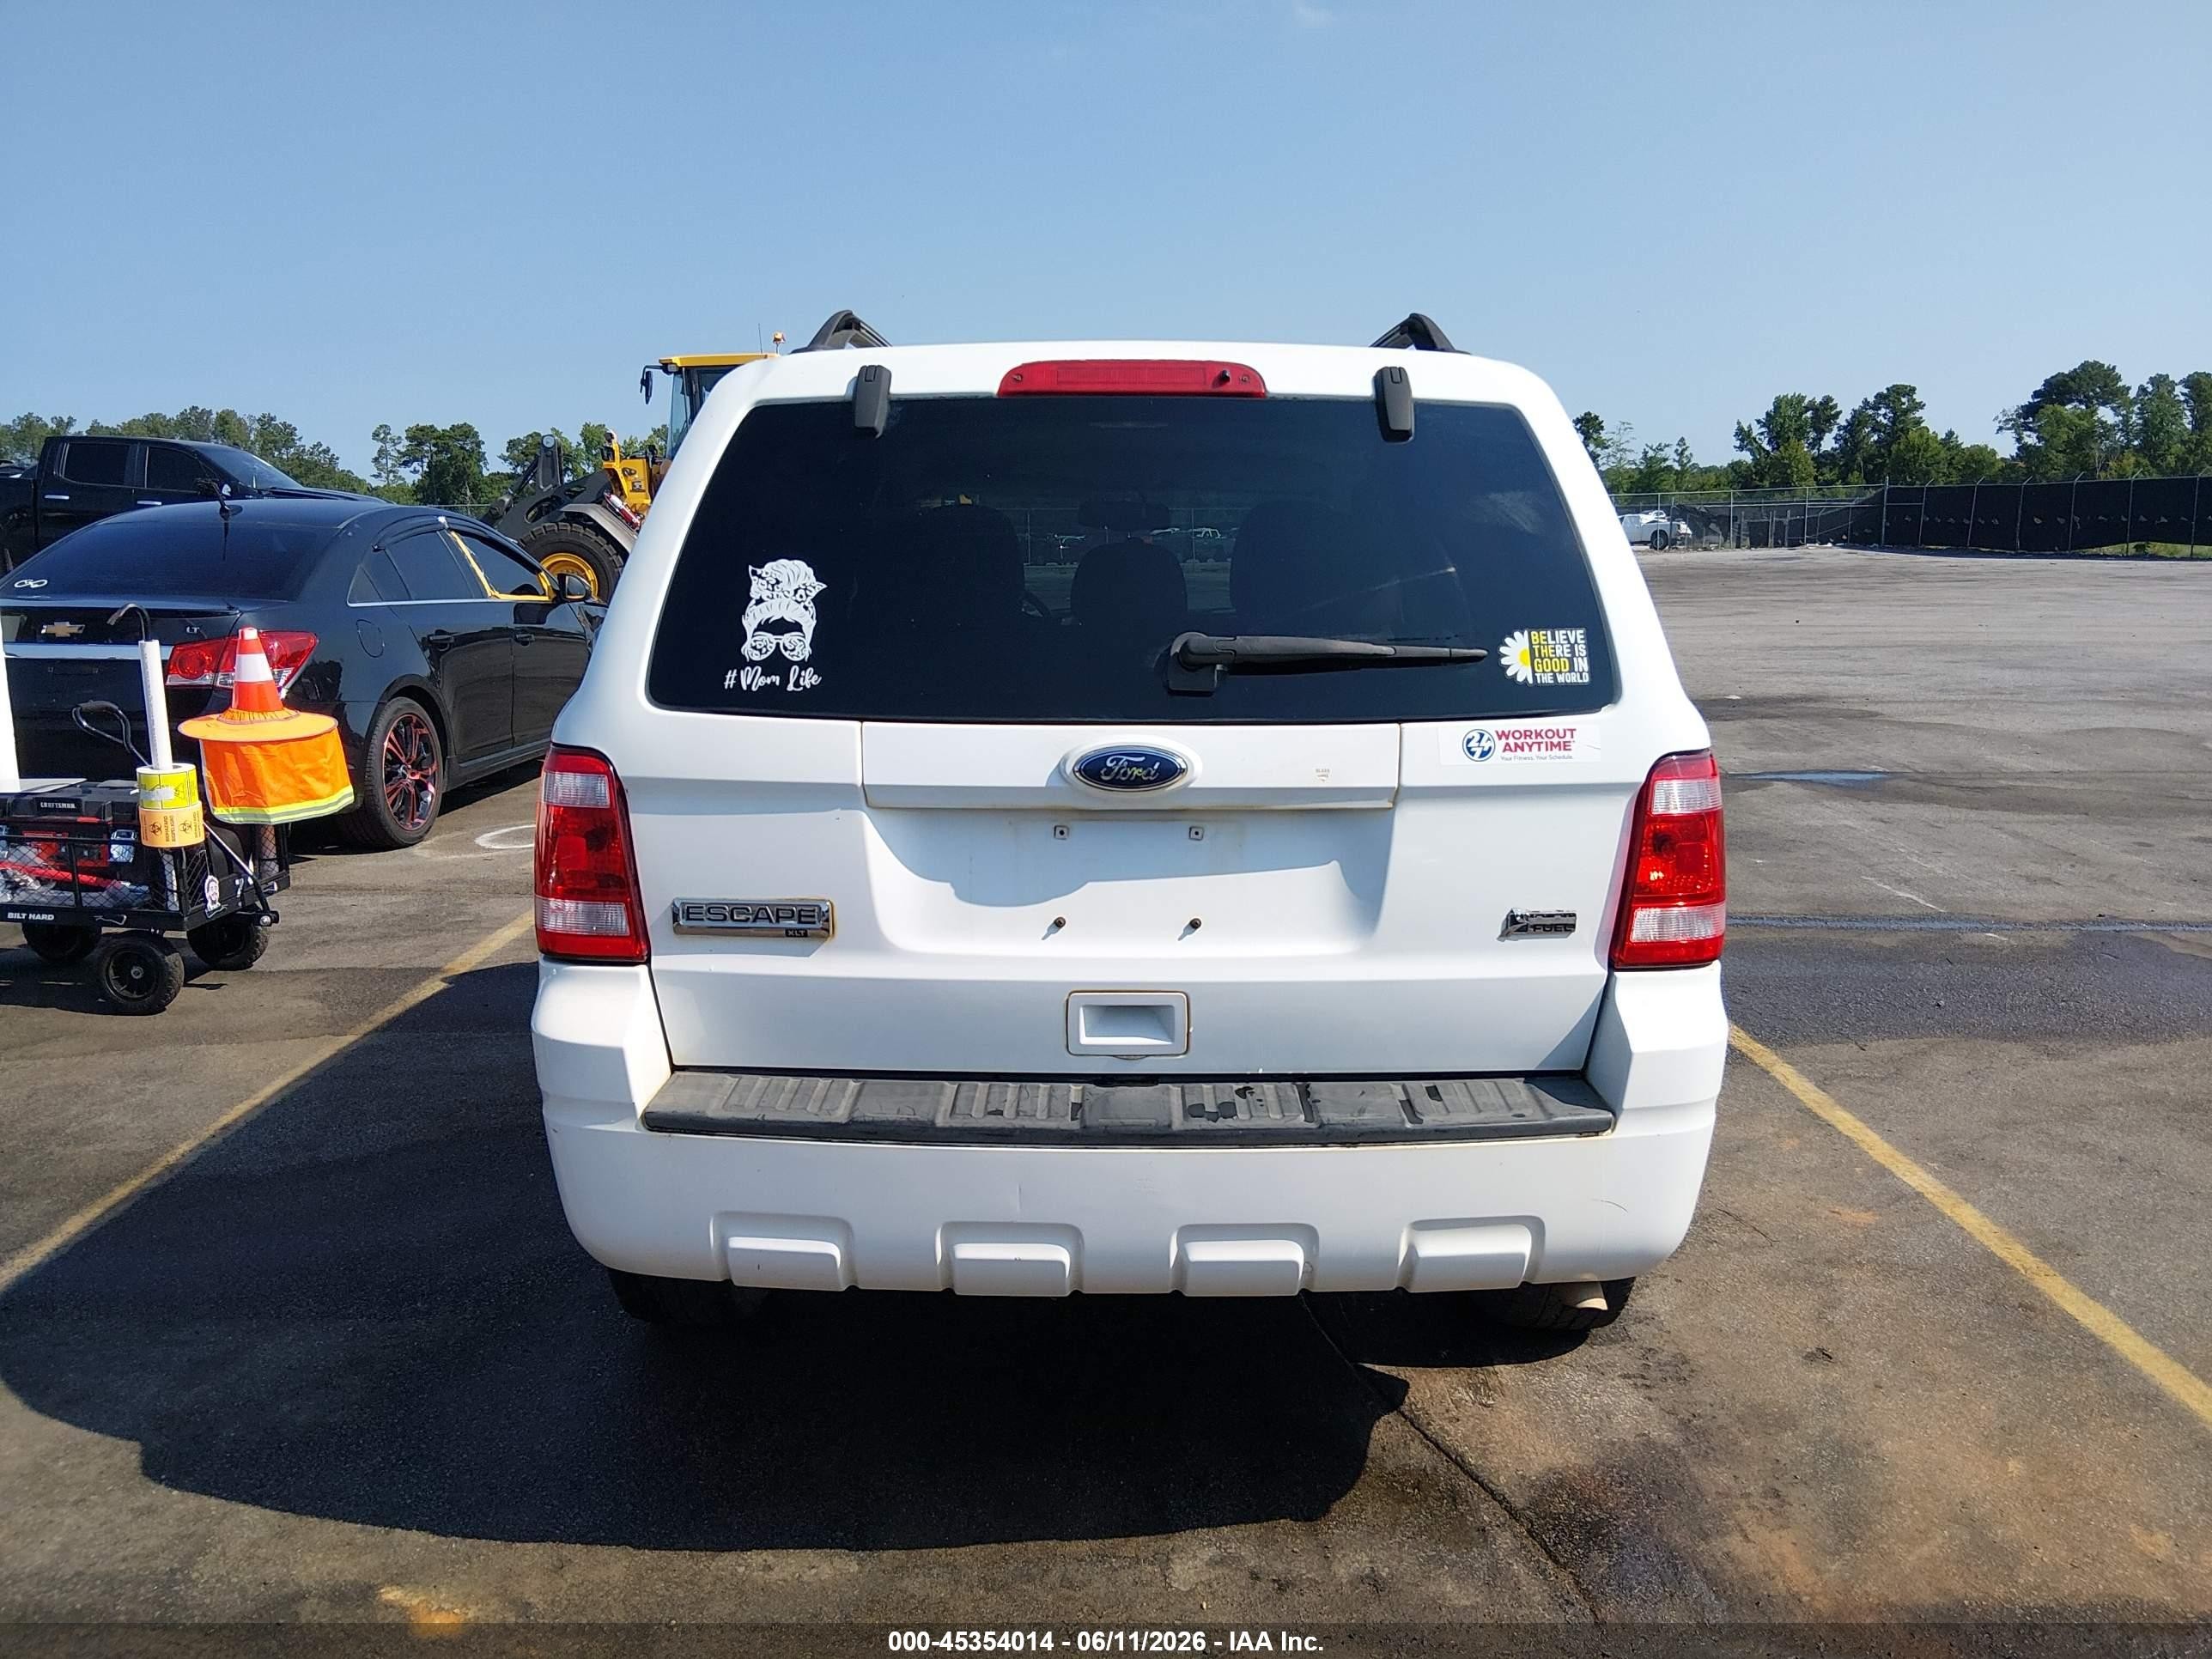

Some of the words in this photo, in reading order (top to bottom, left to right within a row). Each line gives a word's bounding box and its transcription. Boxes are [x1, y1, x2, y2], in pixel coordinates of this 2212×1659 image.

[1530, 630, 1585, 645] BELIEVE
[1533, 644, 1571, 658] THERE
[1574, 644, 1587, 657] IS
[1534, 658, 1570, 673] GOOD
[1573, 657, 1589, 672] IN
[786, 665, 822, 692] Life
[1535, 672, 1554, 684] THE
[1556, 672, 1589, 684] WORLD
[1494, 728, 1577, 741] WORKOUT
[1502, 740, 1573, 753] ANYTIME
[1100, 755, 1160, 781] Ford
[685, 904, 817, 925] ESCAPE
[1533, 923, 1574, 933] FUEL
